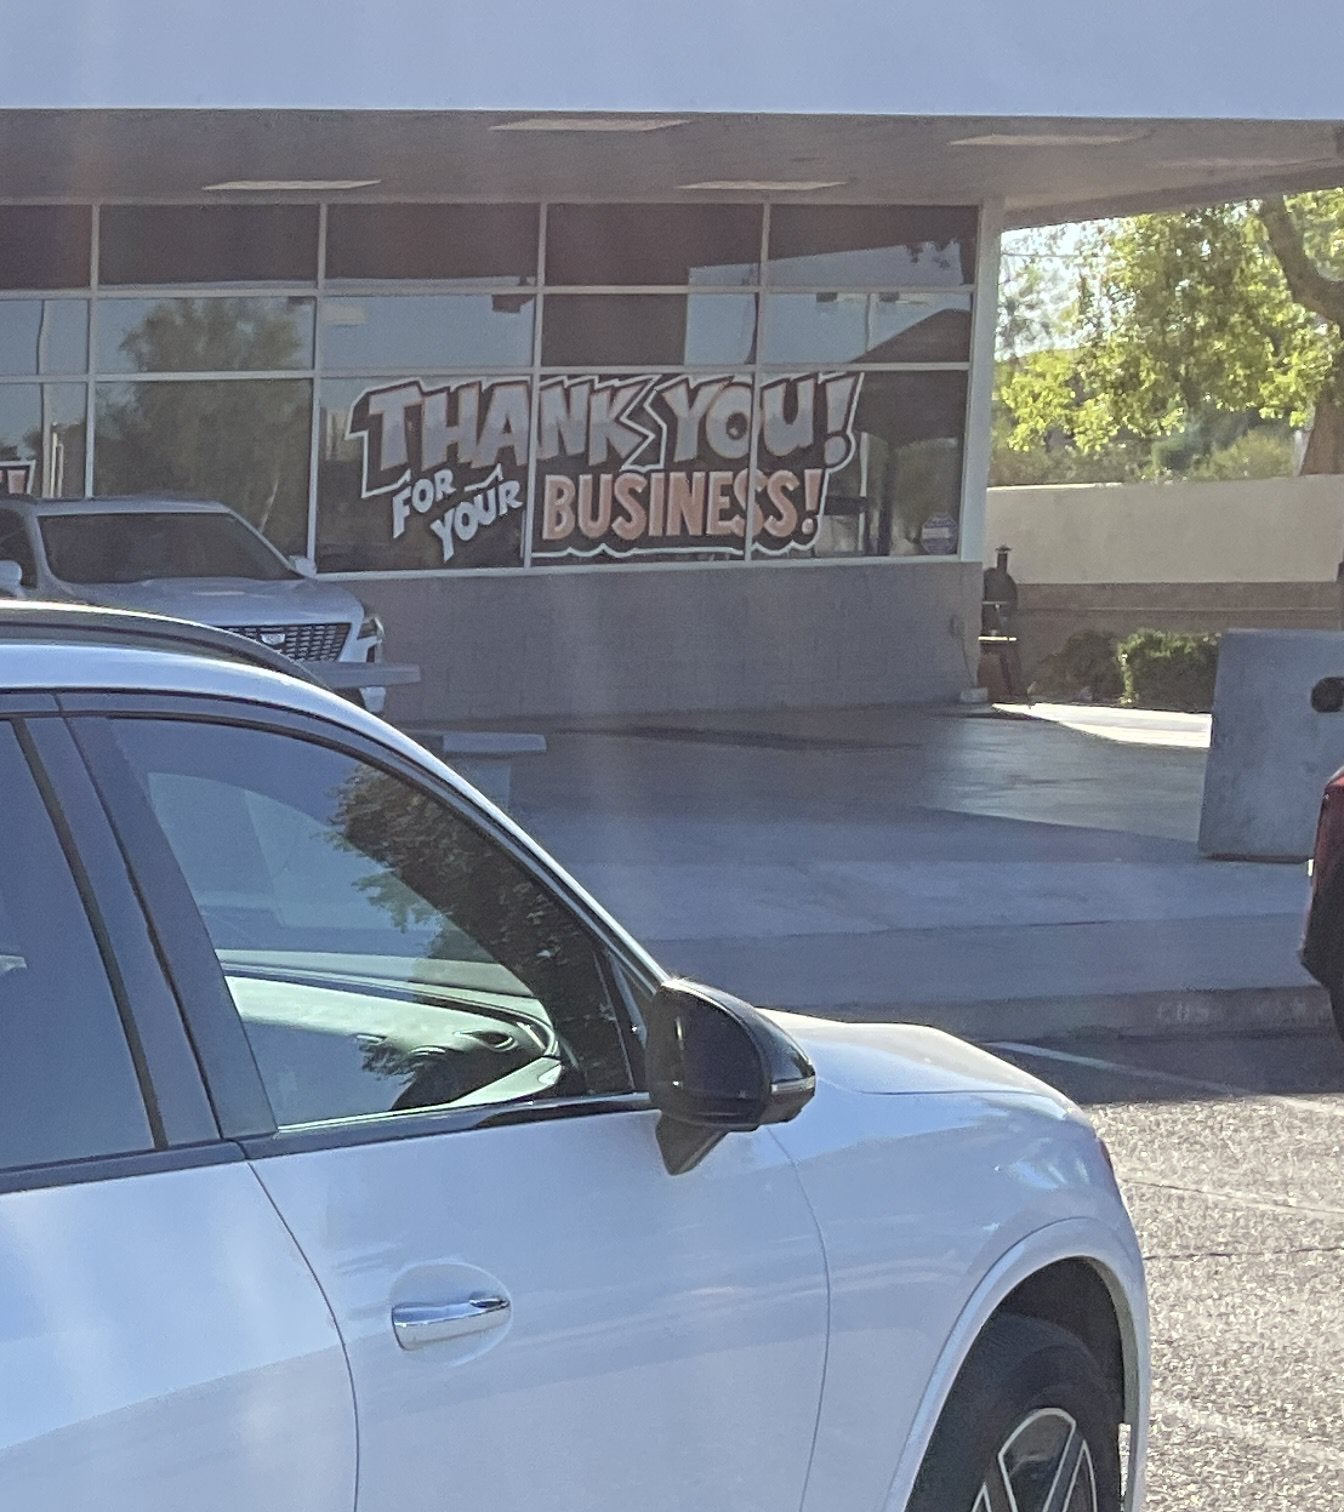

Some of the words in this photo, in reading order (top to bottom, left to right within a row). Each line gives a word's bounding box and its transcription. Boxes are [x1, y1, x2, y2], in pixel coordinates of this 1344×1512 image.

[368, 382, 645, 471] THANK
[662, 375, 856, 466] YOU!
[392, 468, 456, 539] FOR
[430, 480, 523, 562] YOUR
[542, 468, 823, 541] BUSINESS!
